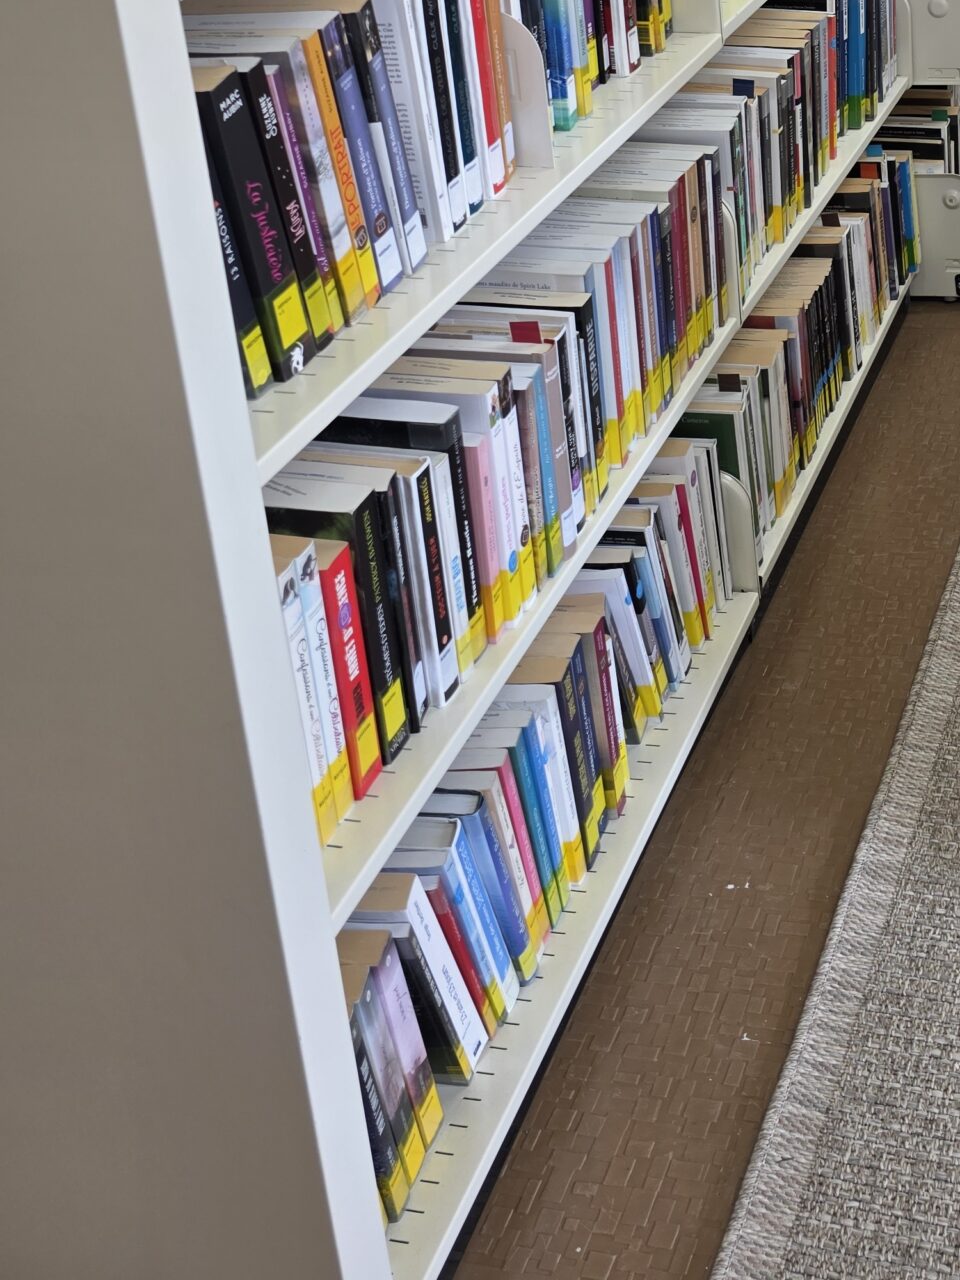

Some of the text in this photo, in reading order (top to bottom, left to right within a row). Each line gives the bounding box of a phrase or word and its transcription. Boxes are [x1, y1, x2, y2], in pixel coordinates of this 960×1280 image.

[219, 88, 241, 113] MARC
[222, 99, 245, 123] AUBIN
[329, 125, 361, 218] PORTRAIT
[215, 206, 241, 281] 13 RAISONS
[585, 318, 600, 399] DISPARUE
[368, 560, 382, 604] PATRICK
[333, 569, 361, 682] ARRÊT D'ENCE
